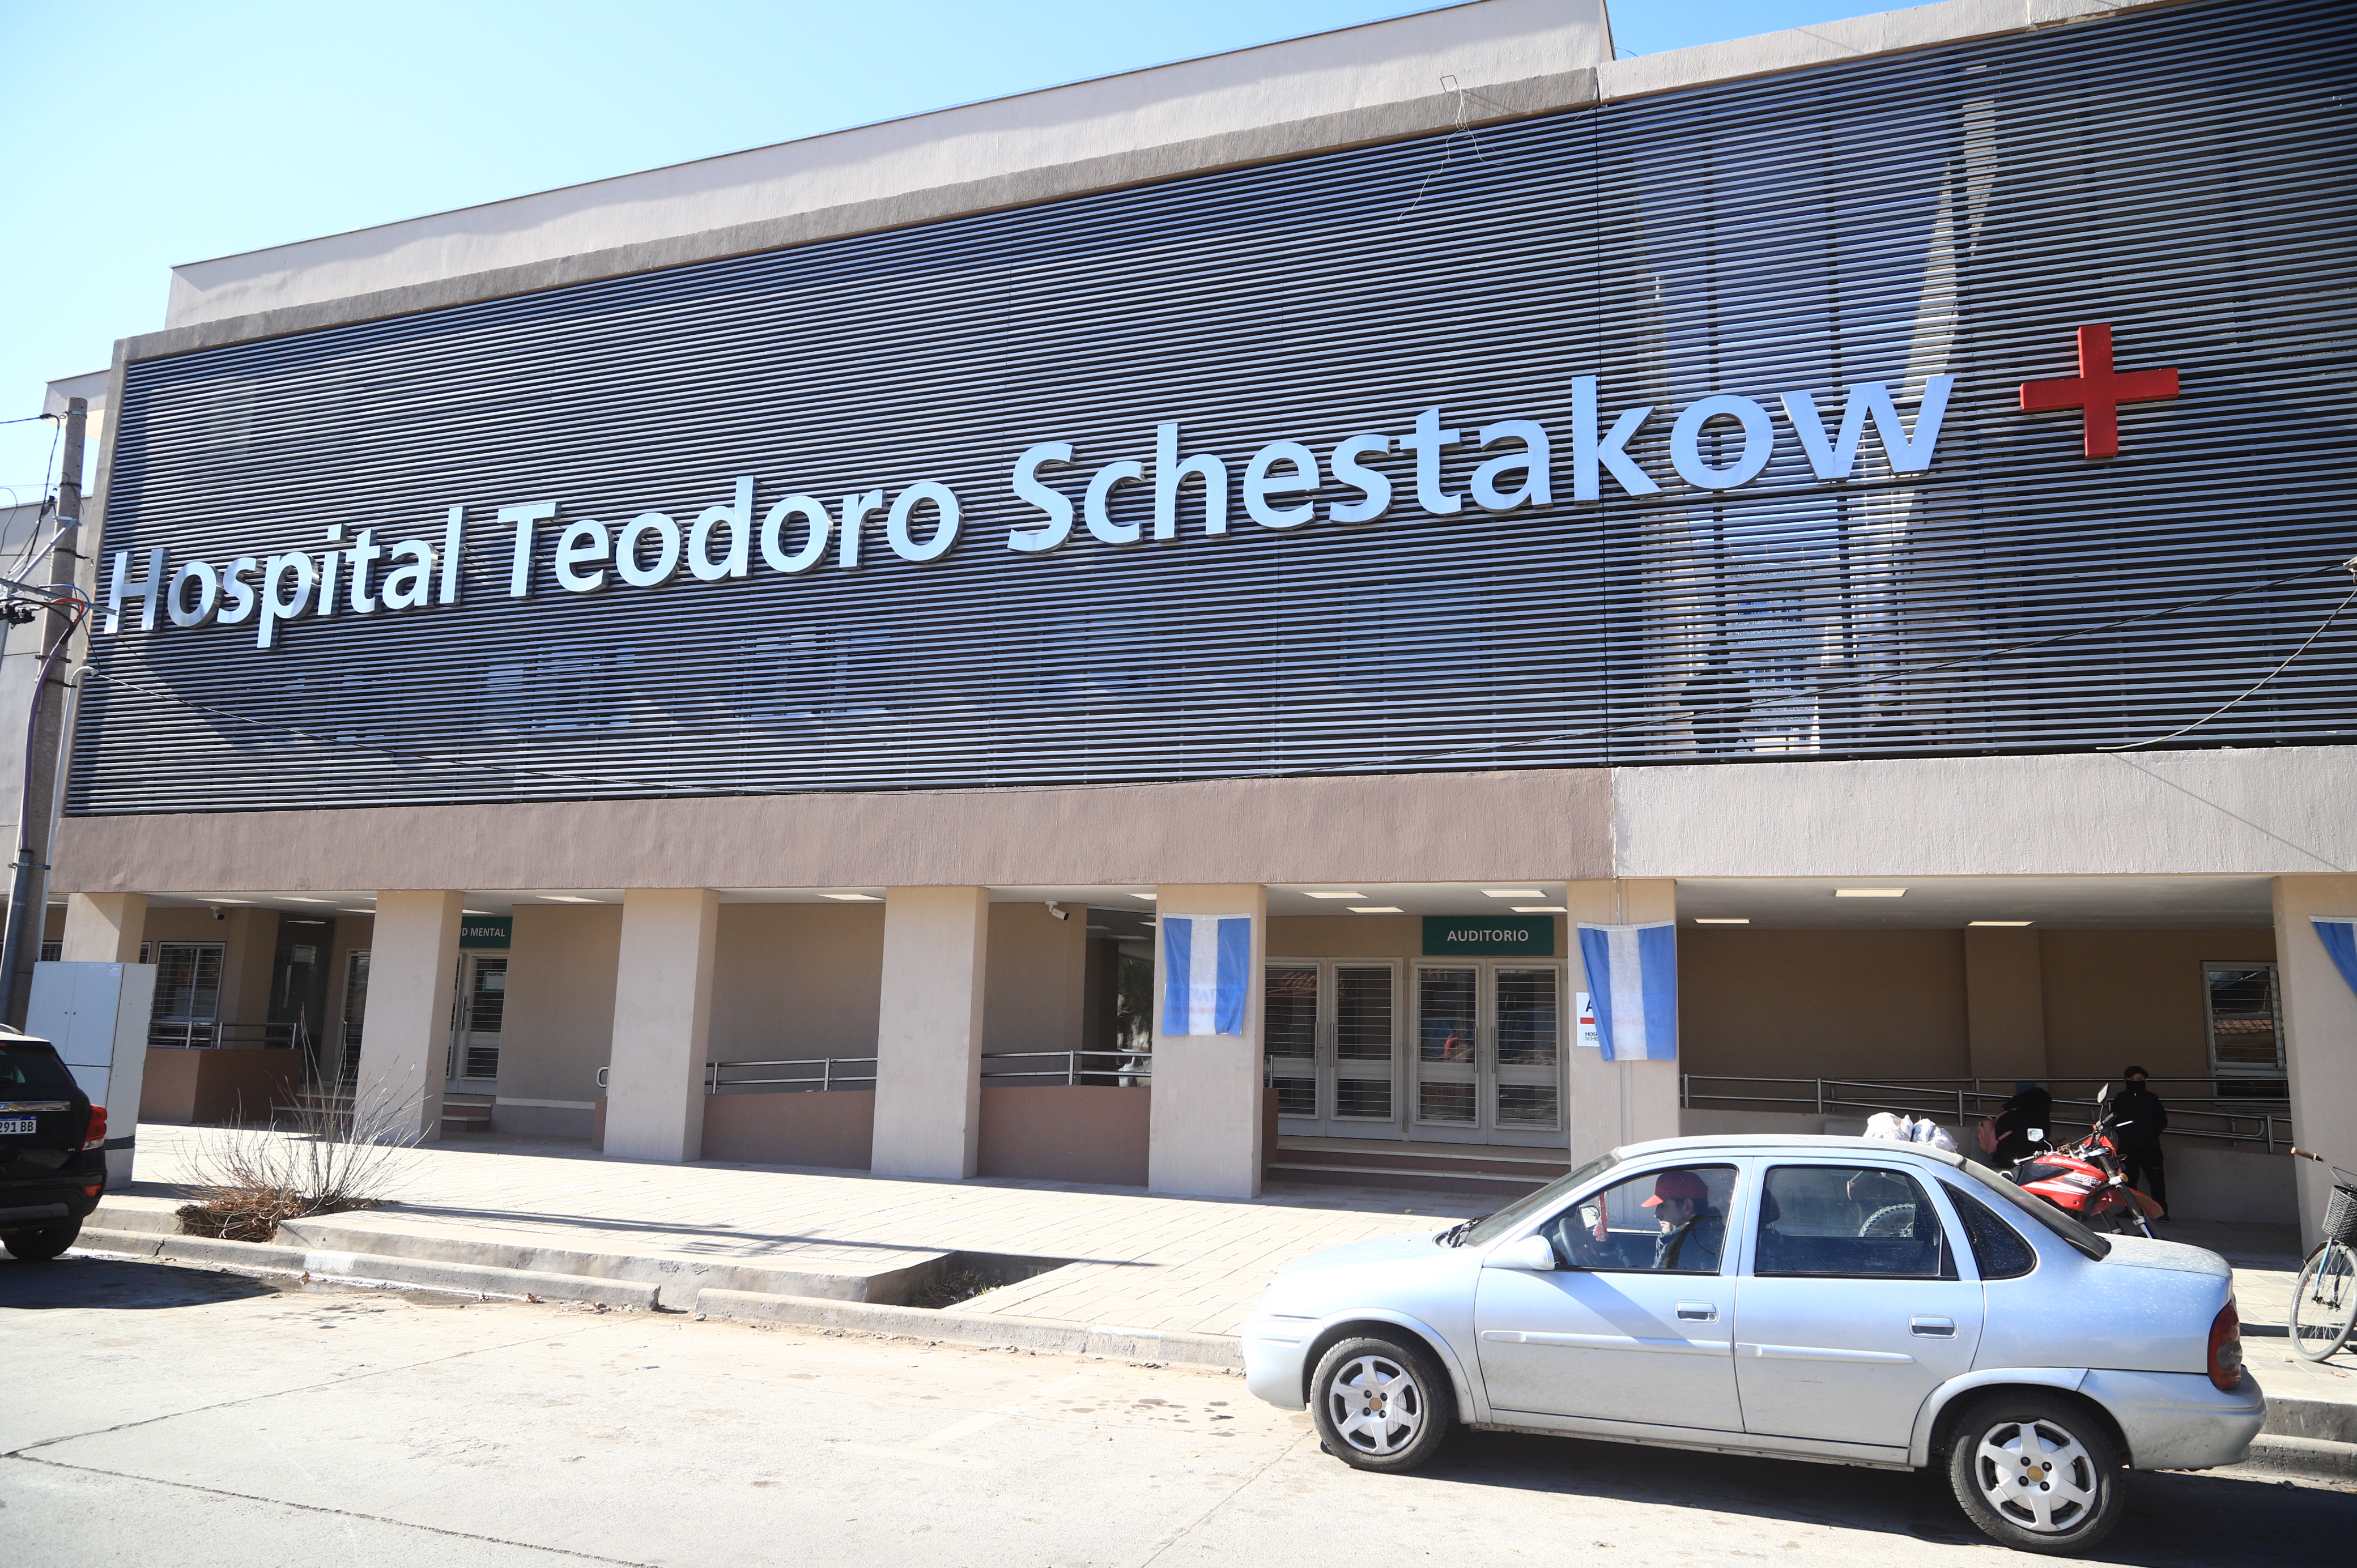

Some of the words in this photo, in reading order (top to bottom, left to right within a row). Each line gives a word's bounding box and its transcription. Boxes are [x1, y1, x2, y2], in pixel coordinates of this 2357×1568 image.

[104, 506, 467, 649] Hospital
[497, 475, 963, 599] Teodoro
[1007, 374, 1955, 553] Schestakow
[462, 927, 468, 936] D
[470, 927, 505, 937] MENTAL
[1446, 930, 1529, 941] AUDITORIO
[20, 1121, 33, 1132] BB
[2049, 1157, 2088, 1169] Motomel
[2074, 1175, 2100, 1184] MOTARD
